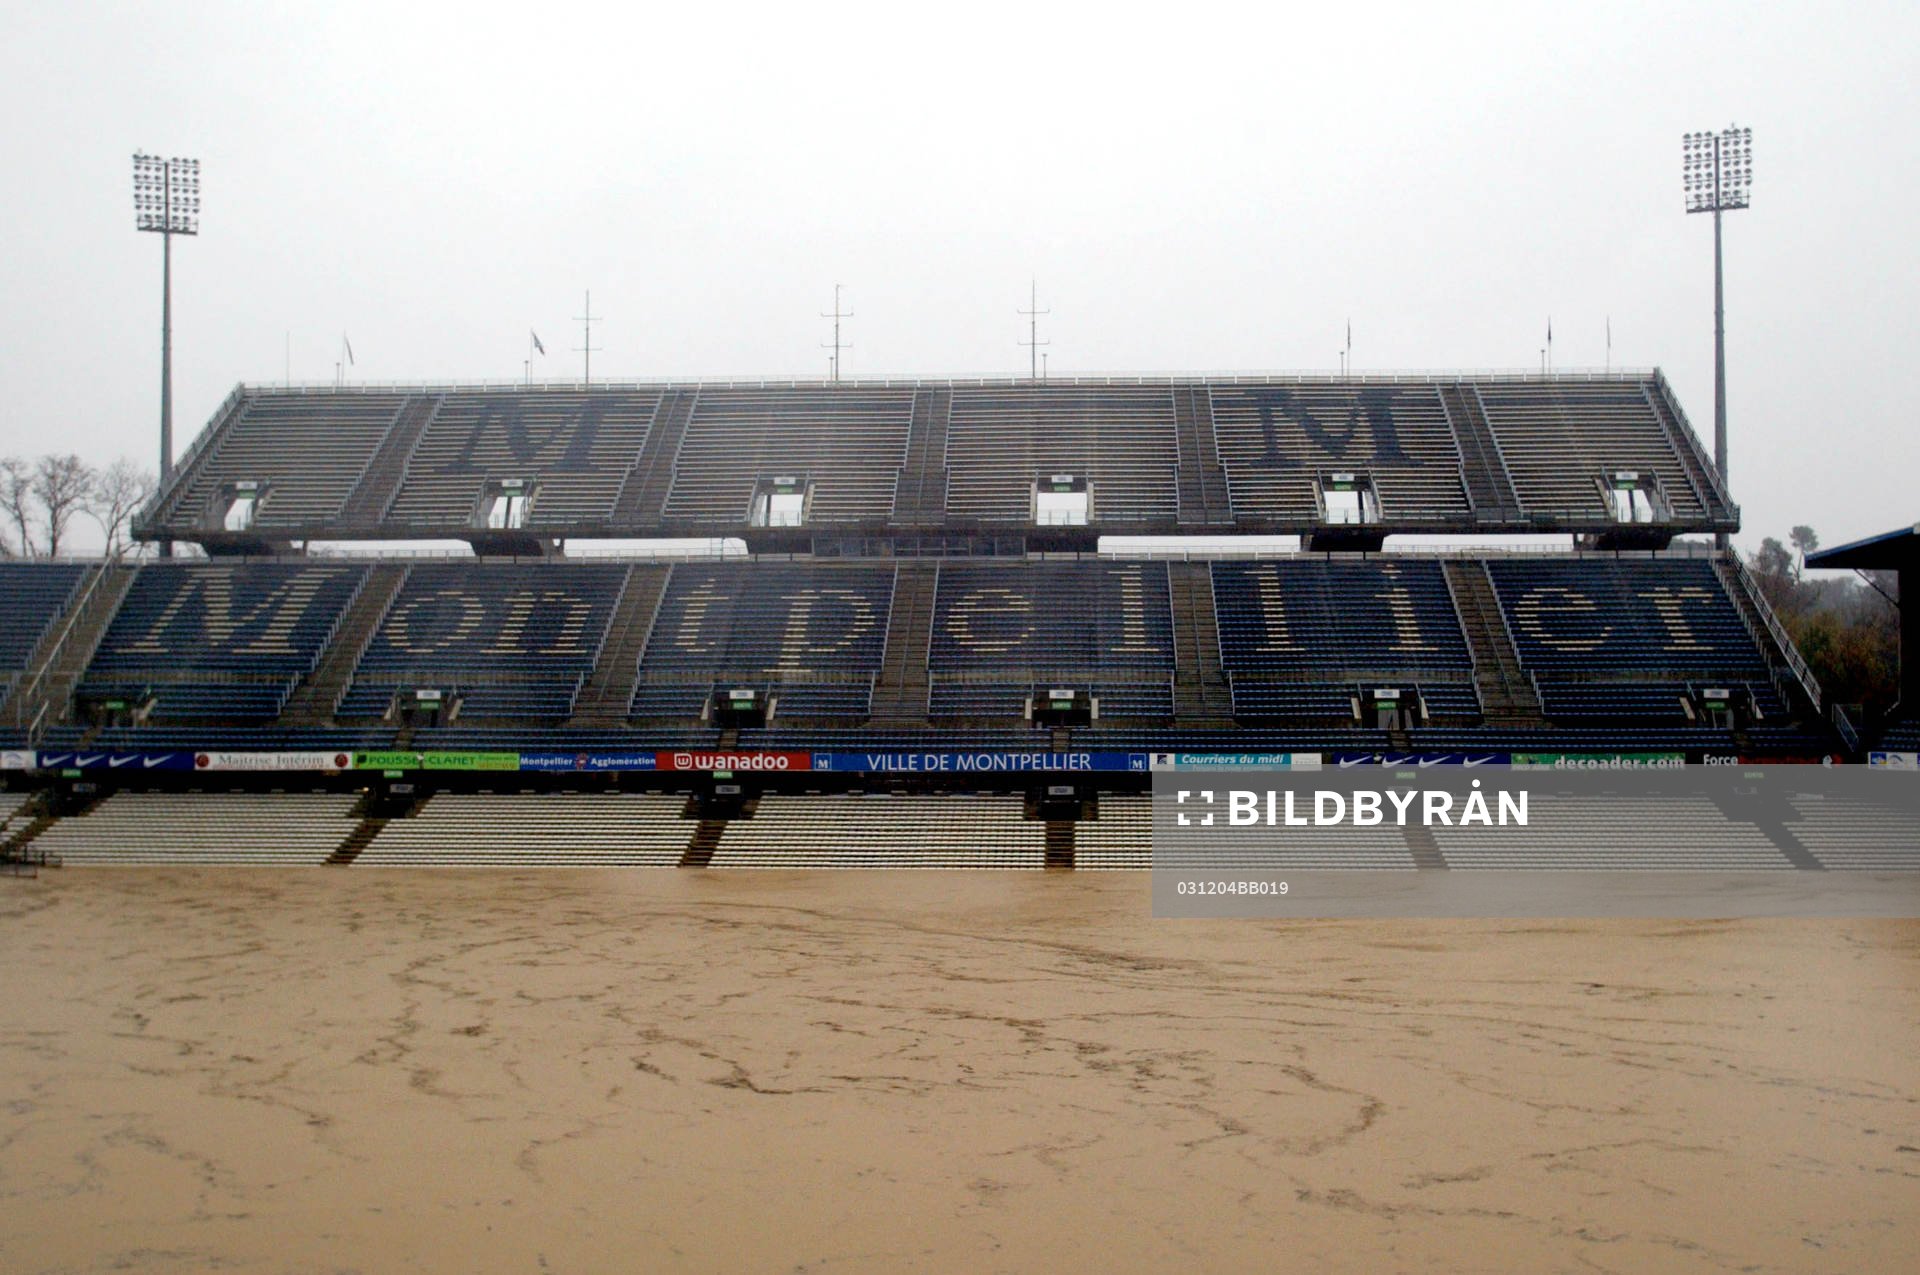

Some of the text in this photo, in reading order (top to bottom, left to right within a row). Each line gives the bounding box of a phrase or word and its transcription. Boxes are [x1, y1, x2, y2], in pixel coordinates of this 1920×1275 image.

[520, 757, 573, 767] Montpellier
[695, 753, 789, 770] wanadoo
[867, 754, 1092, 771] VILLE DE MONTPELLIER
[1181, 754, 1236, 764] Courriers
[1239, 754, 1255, 764] du
[1258, 754, 1284, 764] midi
